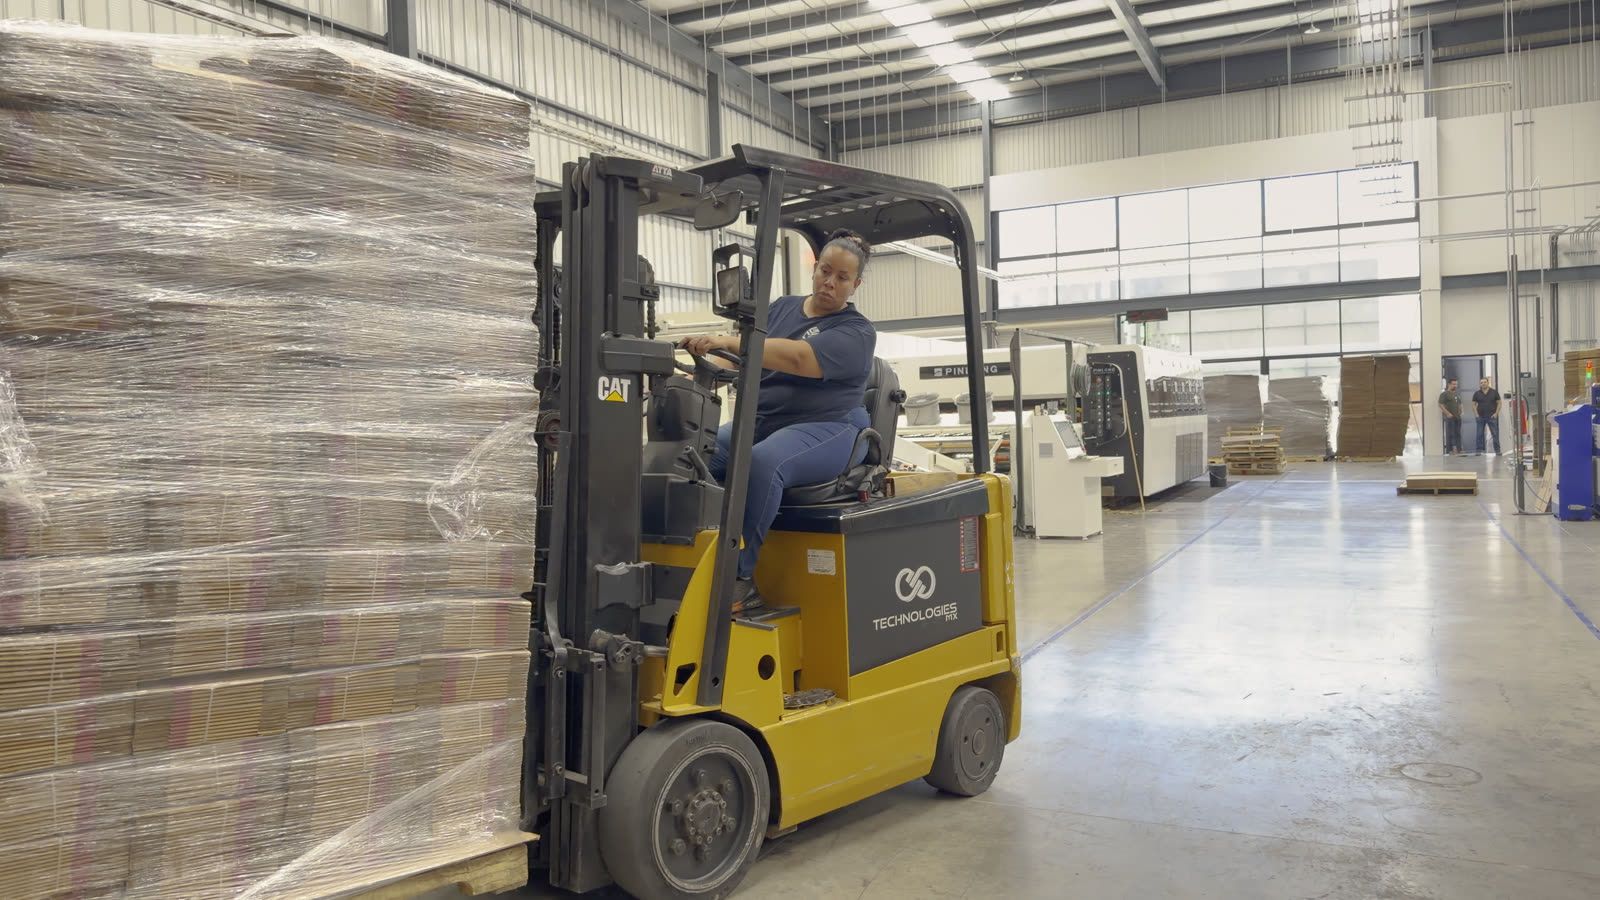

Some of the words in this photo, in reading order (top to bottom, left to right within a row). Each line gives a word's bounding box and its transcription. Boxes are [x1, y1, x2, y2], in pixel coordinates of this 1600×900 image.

[945, 365, 998, 376] PINLNG
[598, 376, 631, 403] CAT
[872, 602, 958, 631] TECHNOLOGIES
